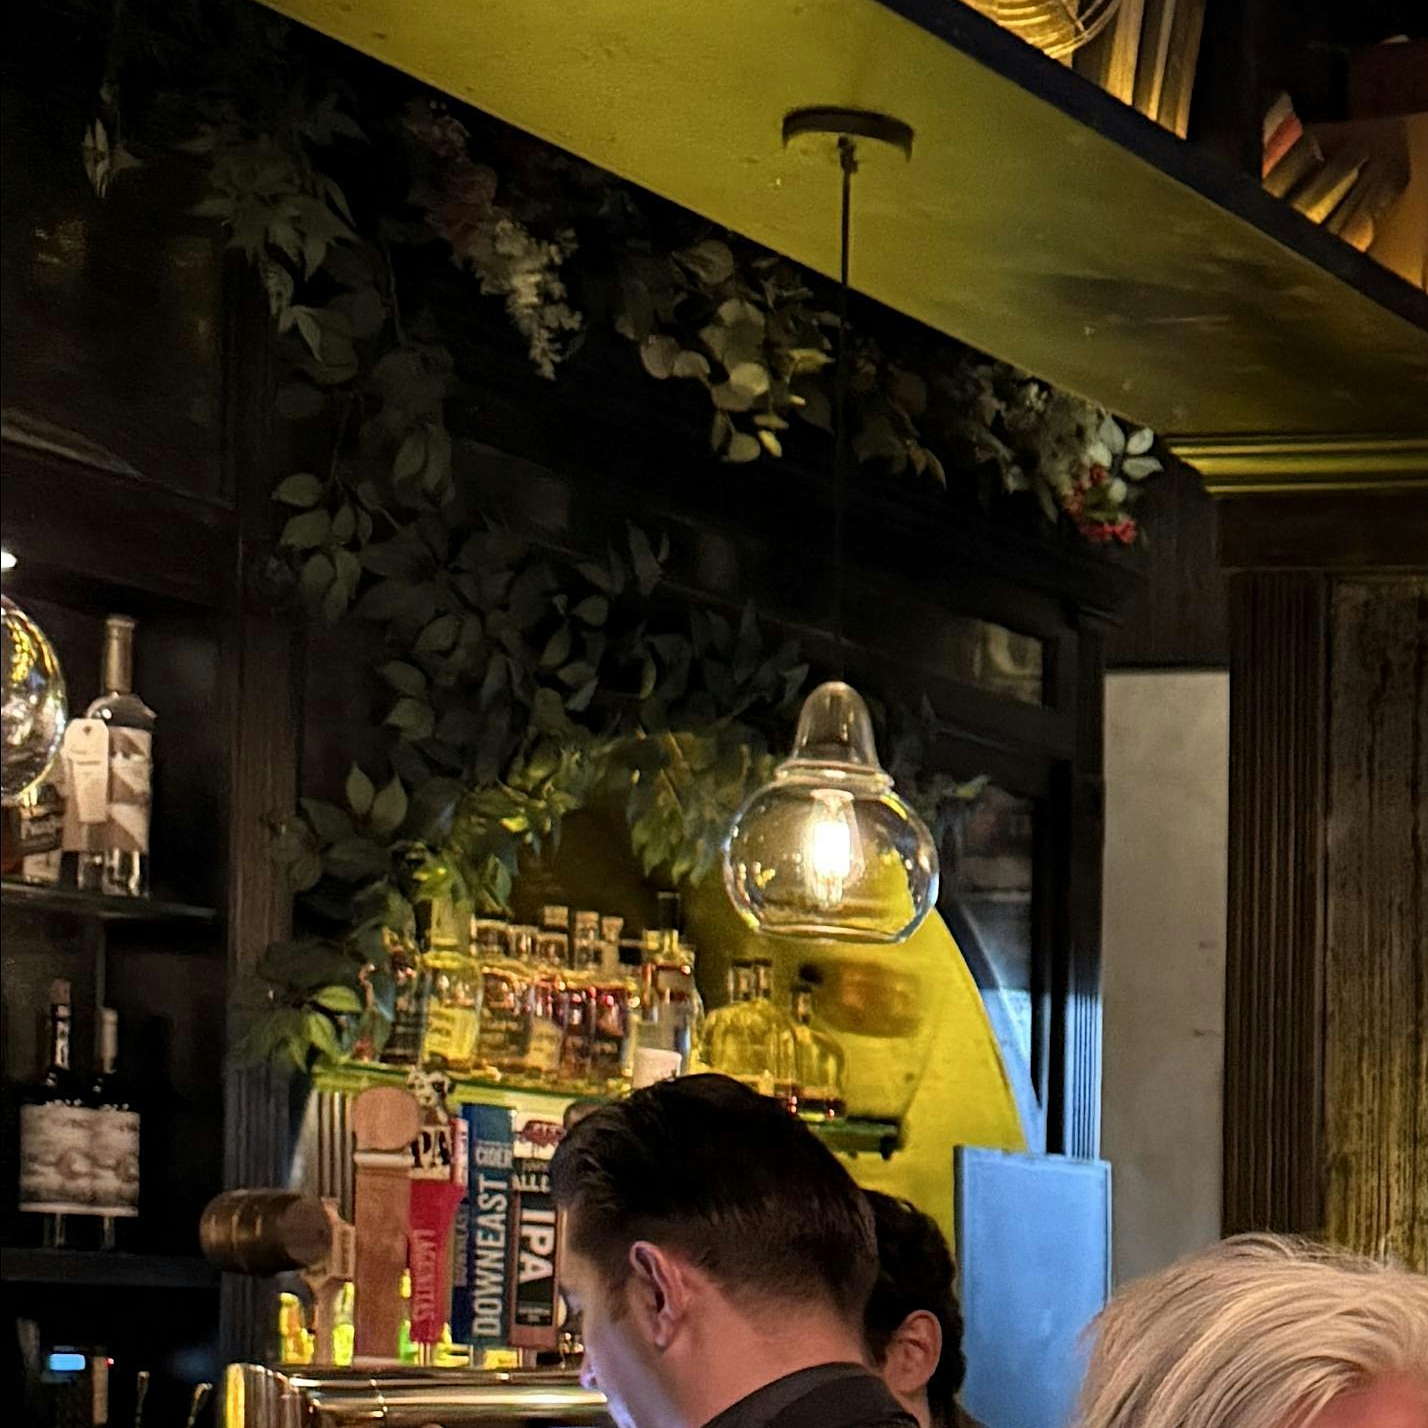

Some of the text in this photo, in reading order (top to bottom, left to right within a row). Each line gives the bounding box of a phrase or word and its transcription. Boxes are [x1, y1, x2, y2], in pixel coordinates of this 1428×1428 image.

[411, 1129, 451, 1170] PA
[474, 1142, 513, 1169] CIDER
[472, 1174, 508, 1338] DOWNEAST
[518, 1209, 557, 1284] IPA
